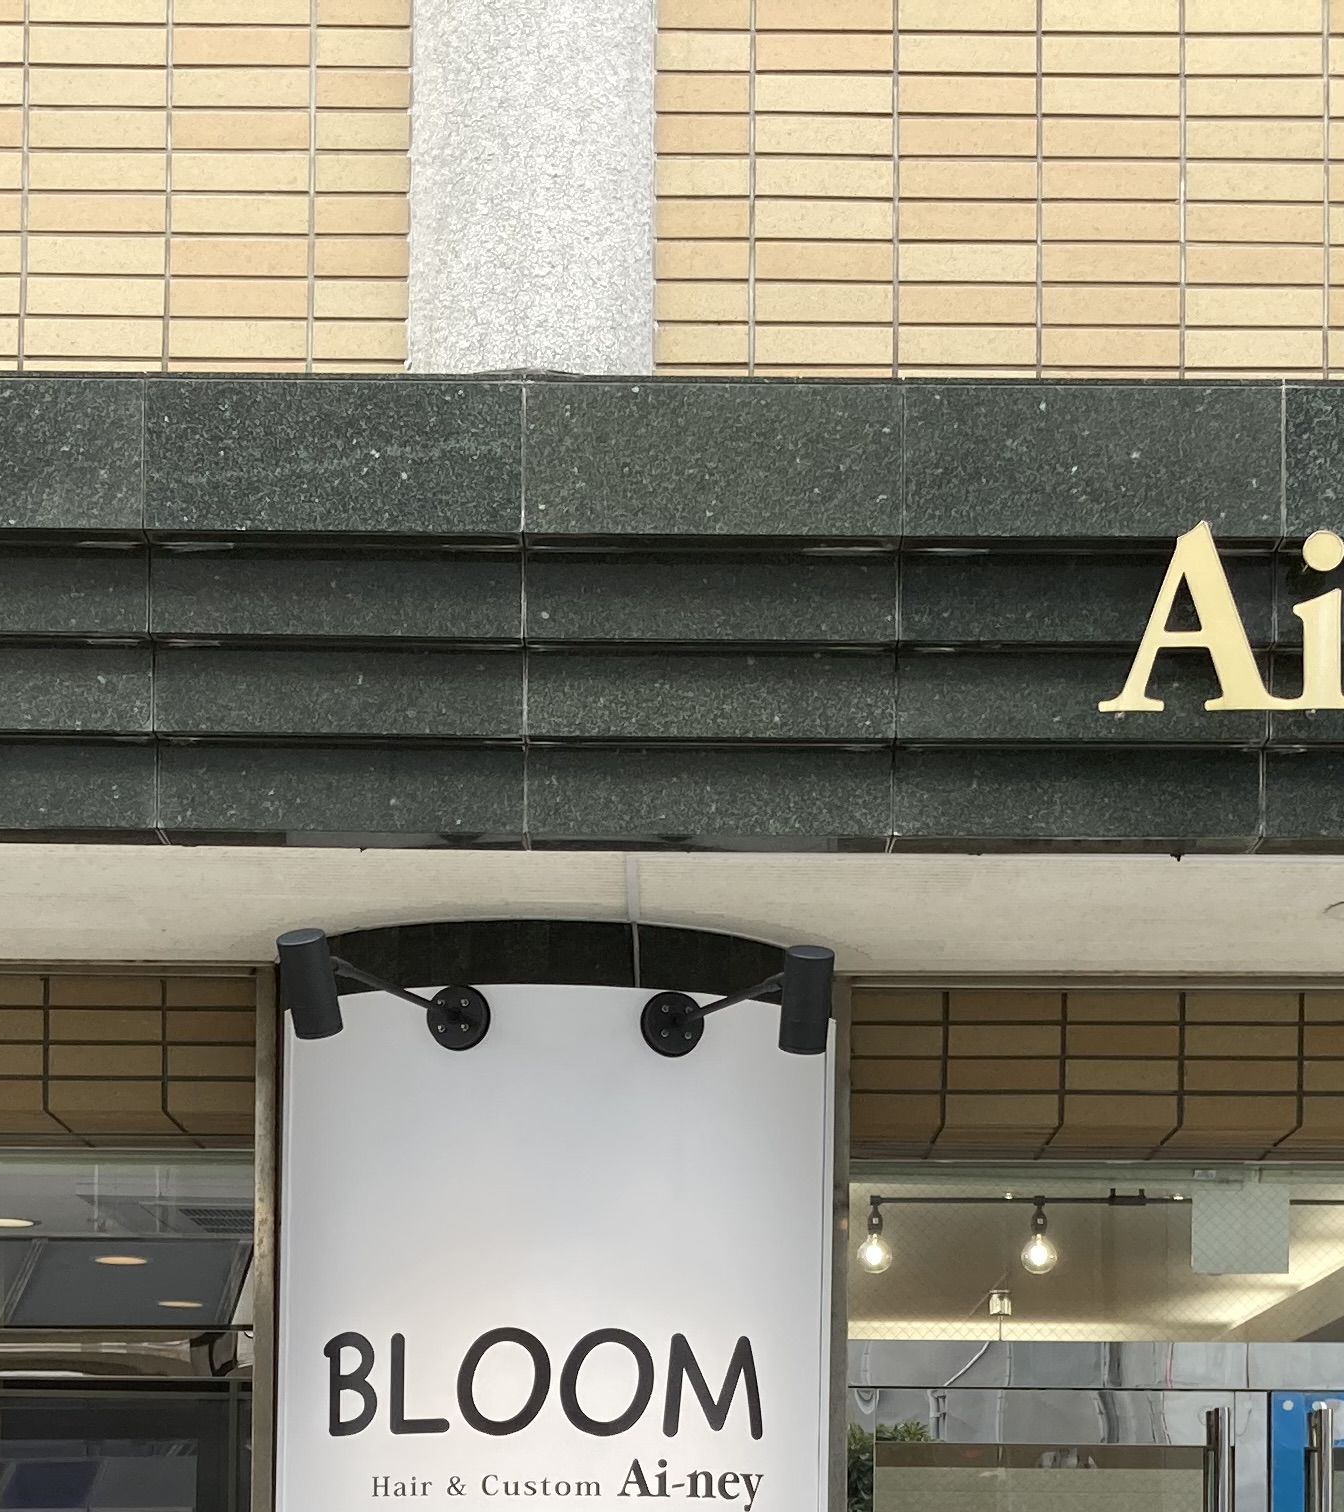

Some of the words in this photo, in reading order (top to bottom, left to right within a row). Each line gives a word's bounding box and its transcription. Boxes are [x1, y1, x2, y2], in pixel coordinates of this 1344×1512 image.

[323, 1326, 764, 1441] BLOOM
[370, 1474, 434, 1499] Hair
[445, 1474, 468, 1498] &
[480, 1473, 603, 1498] Custom
[616, 1458, 765, 1512] Ai-ney
